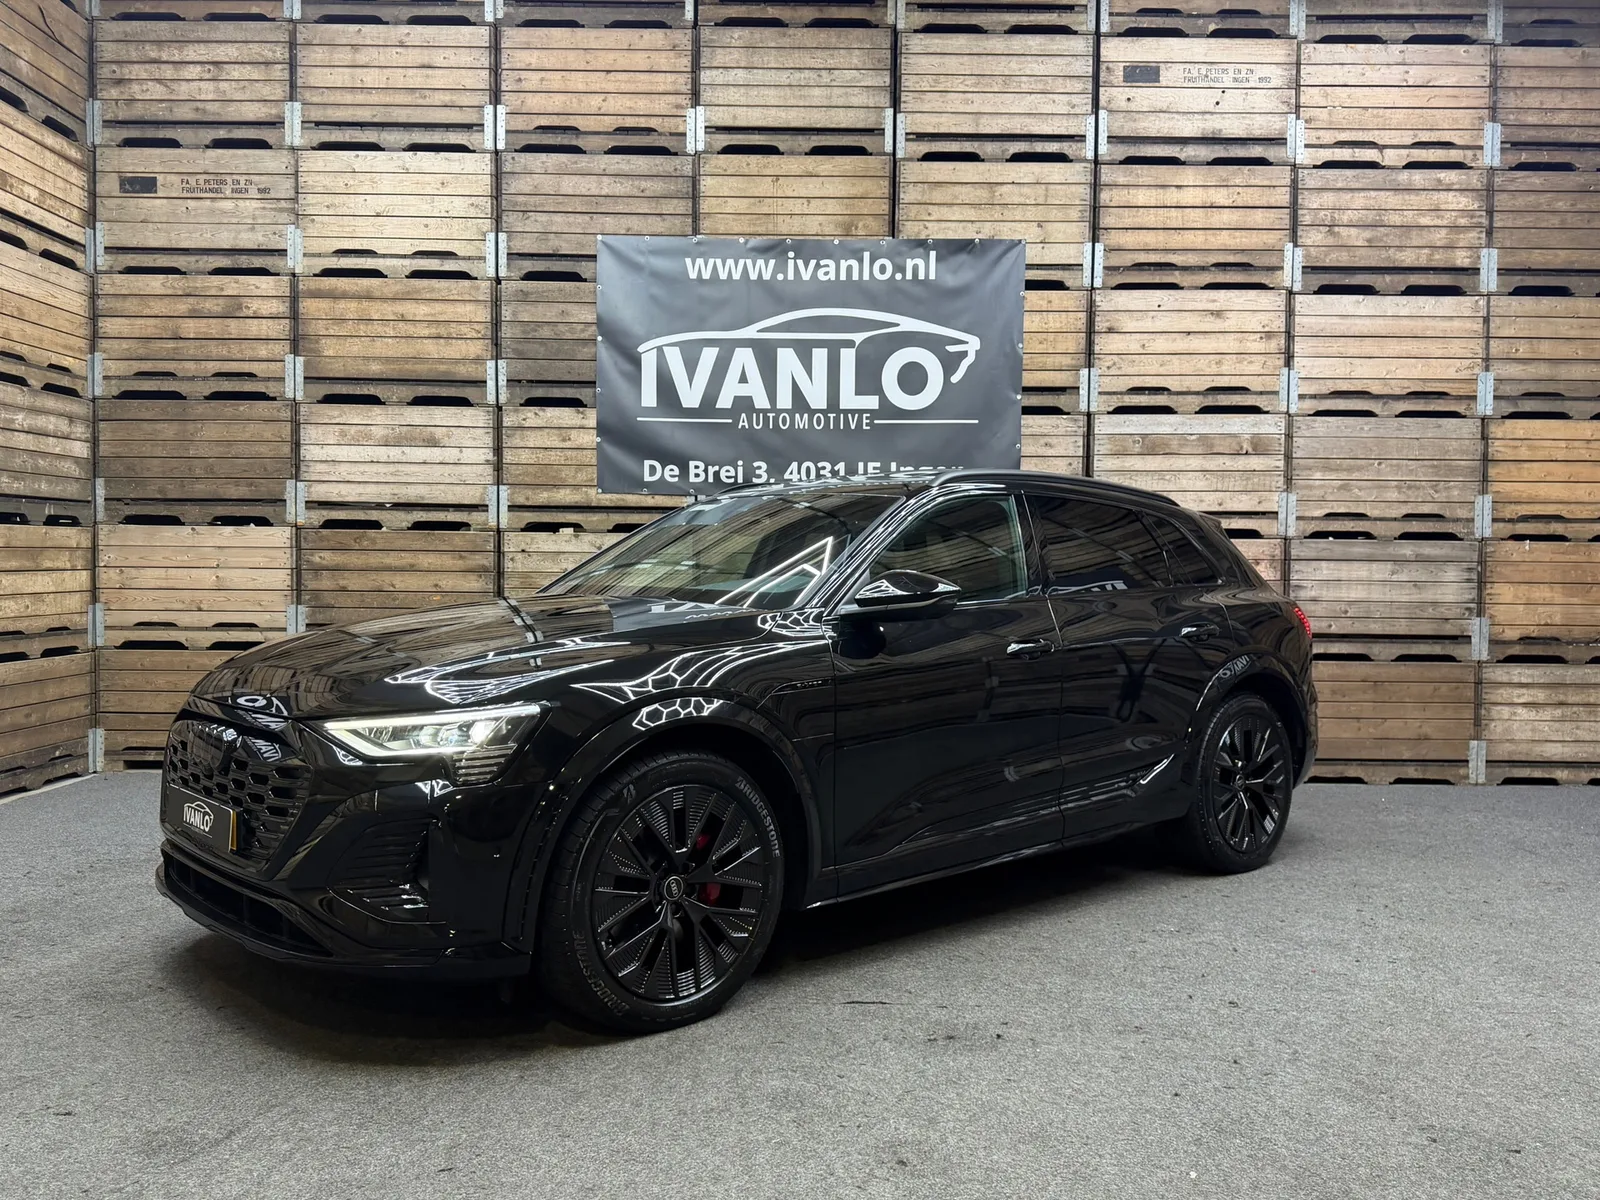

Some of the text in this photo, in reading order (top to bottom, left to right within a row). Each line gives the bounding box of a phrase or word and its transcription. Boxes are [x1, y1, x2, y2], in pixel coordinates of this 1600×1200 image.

[1183, 76, 1225, 84] FRUITHANDEL
[1231, 76, 1250, 84] INGEN
[180, 178, 191, 186] FA.
[203, 178, 228, 186] PETERS
[231, 178, 241, 186] EN
[244, 178, 253, 186] ZN
[181, 186, 224, 194] FRUITHANDEL
[685, 251, 937, 281] www.ivanlo.nl
[640, 346, 944, 411] IVANLO
[738, 412, 871, 430] AUTOMOTIVE
[643, 459, 680, 483] De
[688, 459, 744, 484] Brei
[783, 461, 846, 482] 4031
[183, 806, 211, 832] IVANLO
[734, 775, 781, 858] BRIDGESTONE
